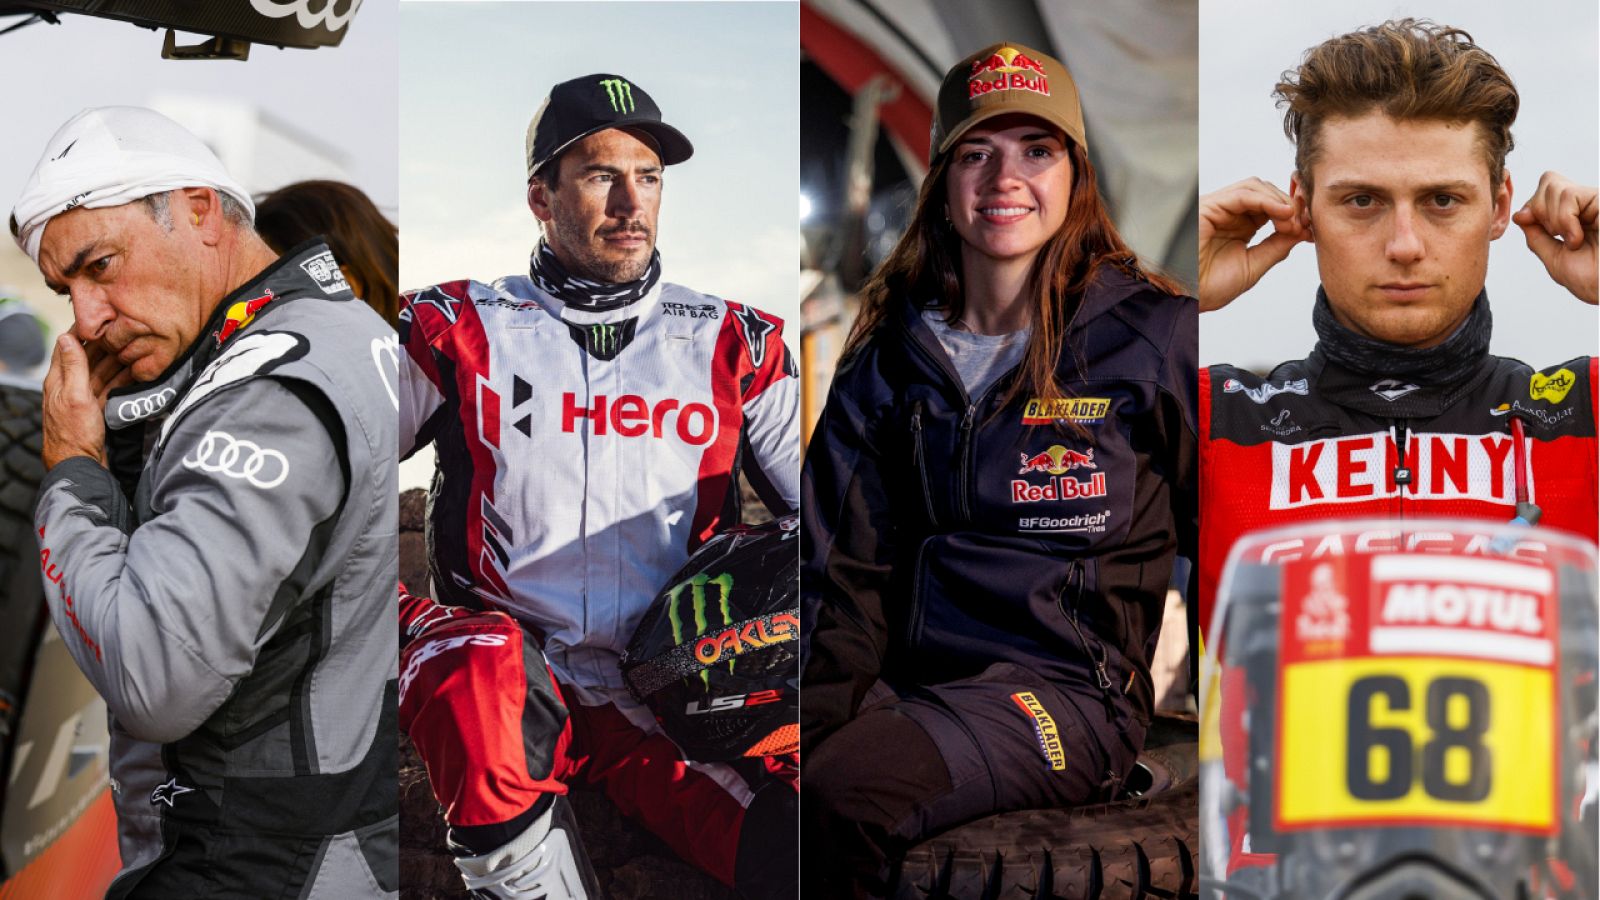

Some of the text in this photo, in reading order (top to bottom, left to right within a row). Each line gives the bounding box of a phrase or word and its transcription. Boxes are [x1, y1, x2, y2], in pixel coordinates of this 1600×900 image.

[969, 72, 1051, 100] Red Bull
[561, 392, 715, 446] Hero
[1289, 436, 1514, 504] KENNY
[1011, 472, 1107, 503] Red Bull
[1019, 513, 1106, 529] BFGoodrich
[1087, 524, 1106, 534] Tires
[1381, 583, 1543, 634] MOTUL
[686, 688, 783, 715] LS2
[1345, 673, 1493, 805] 68
